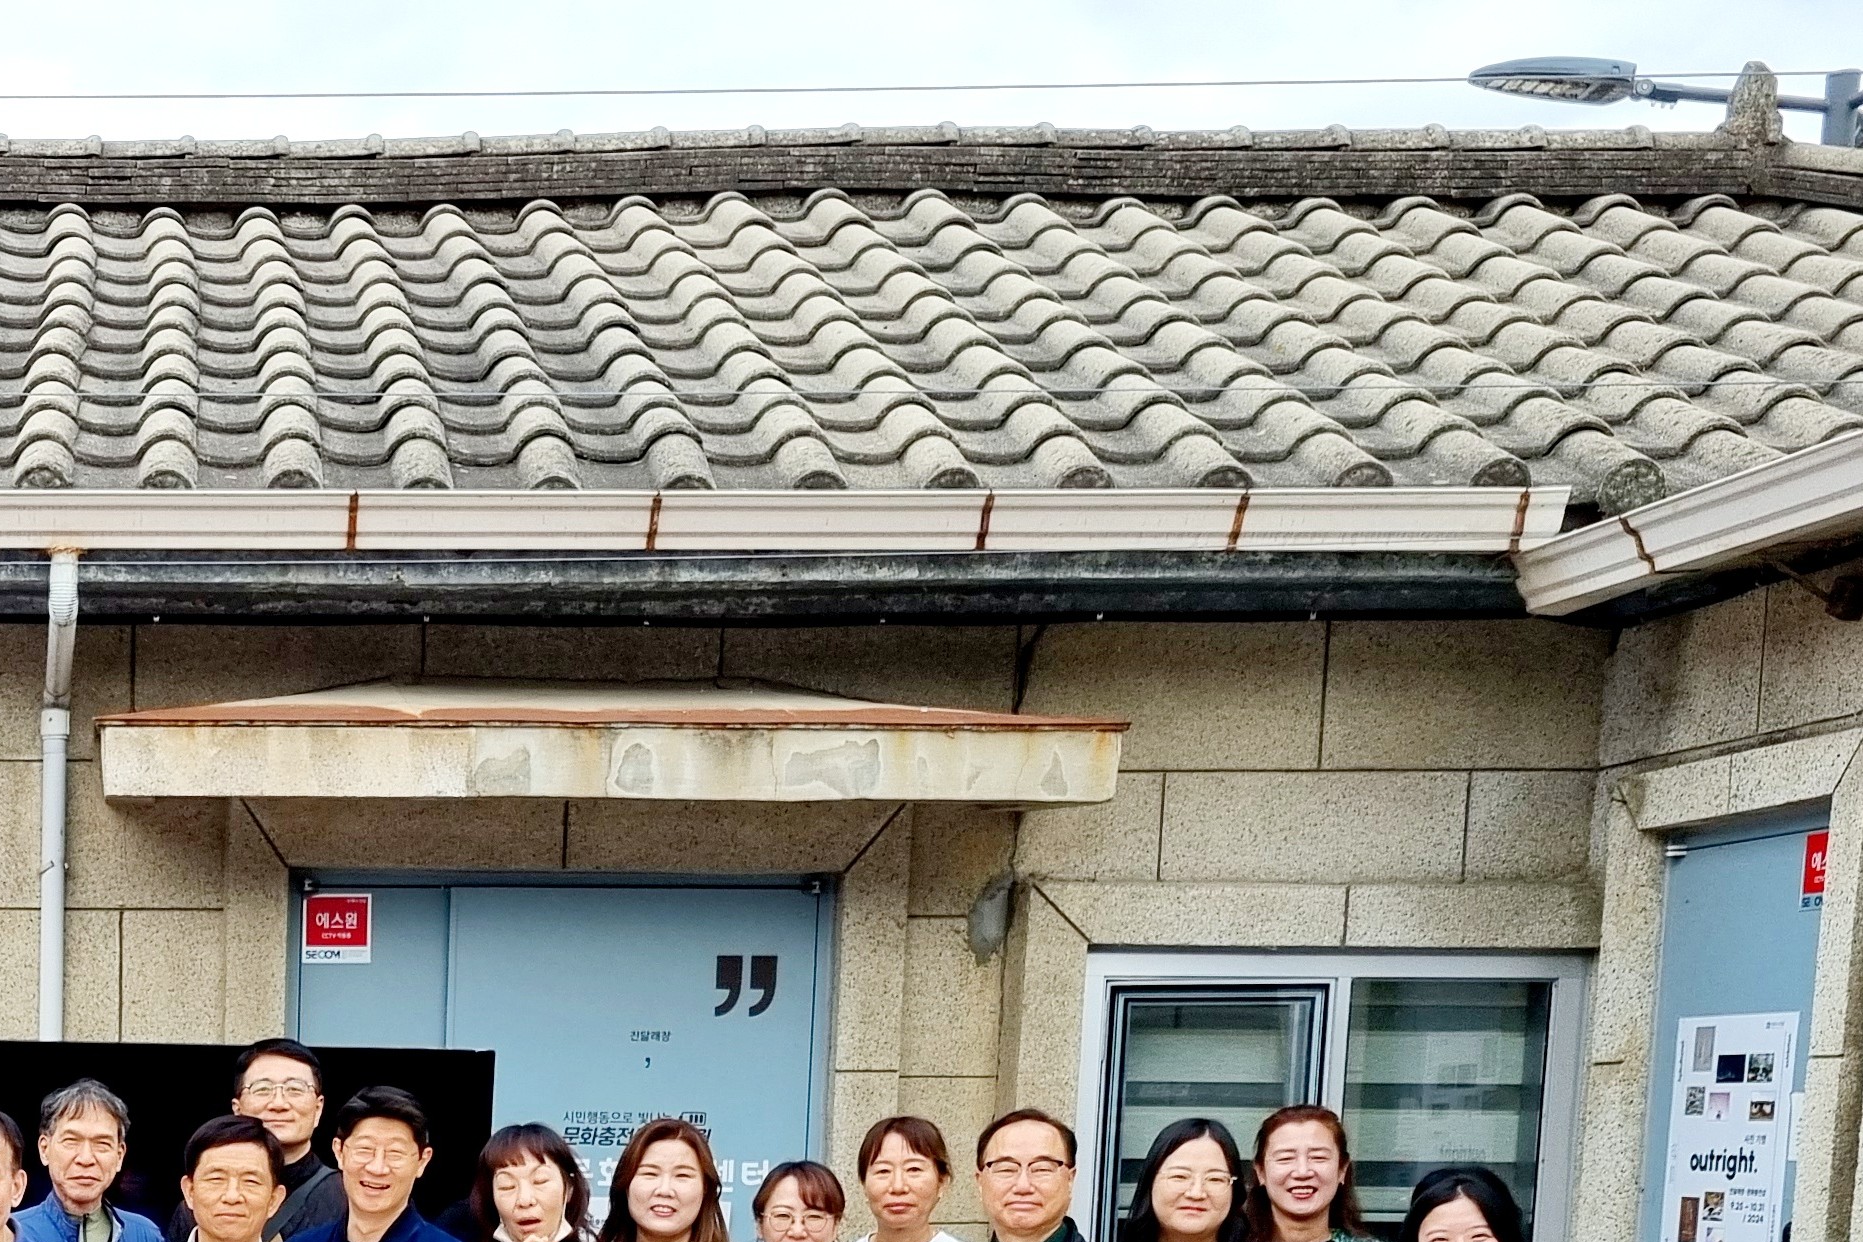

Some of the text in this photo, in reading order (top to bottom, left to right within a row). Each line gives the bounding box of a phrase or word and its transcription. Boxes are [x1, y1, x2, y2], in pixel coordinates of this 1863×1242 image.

[315, 911, 358, 930] 에스원
[562, 1110, 634, 1125] 시민행동으로
[1689, 1146, 1758, 1181] outright.
